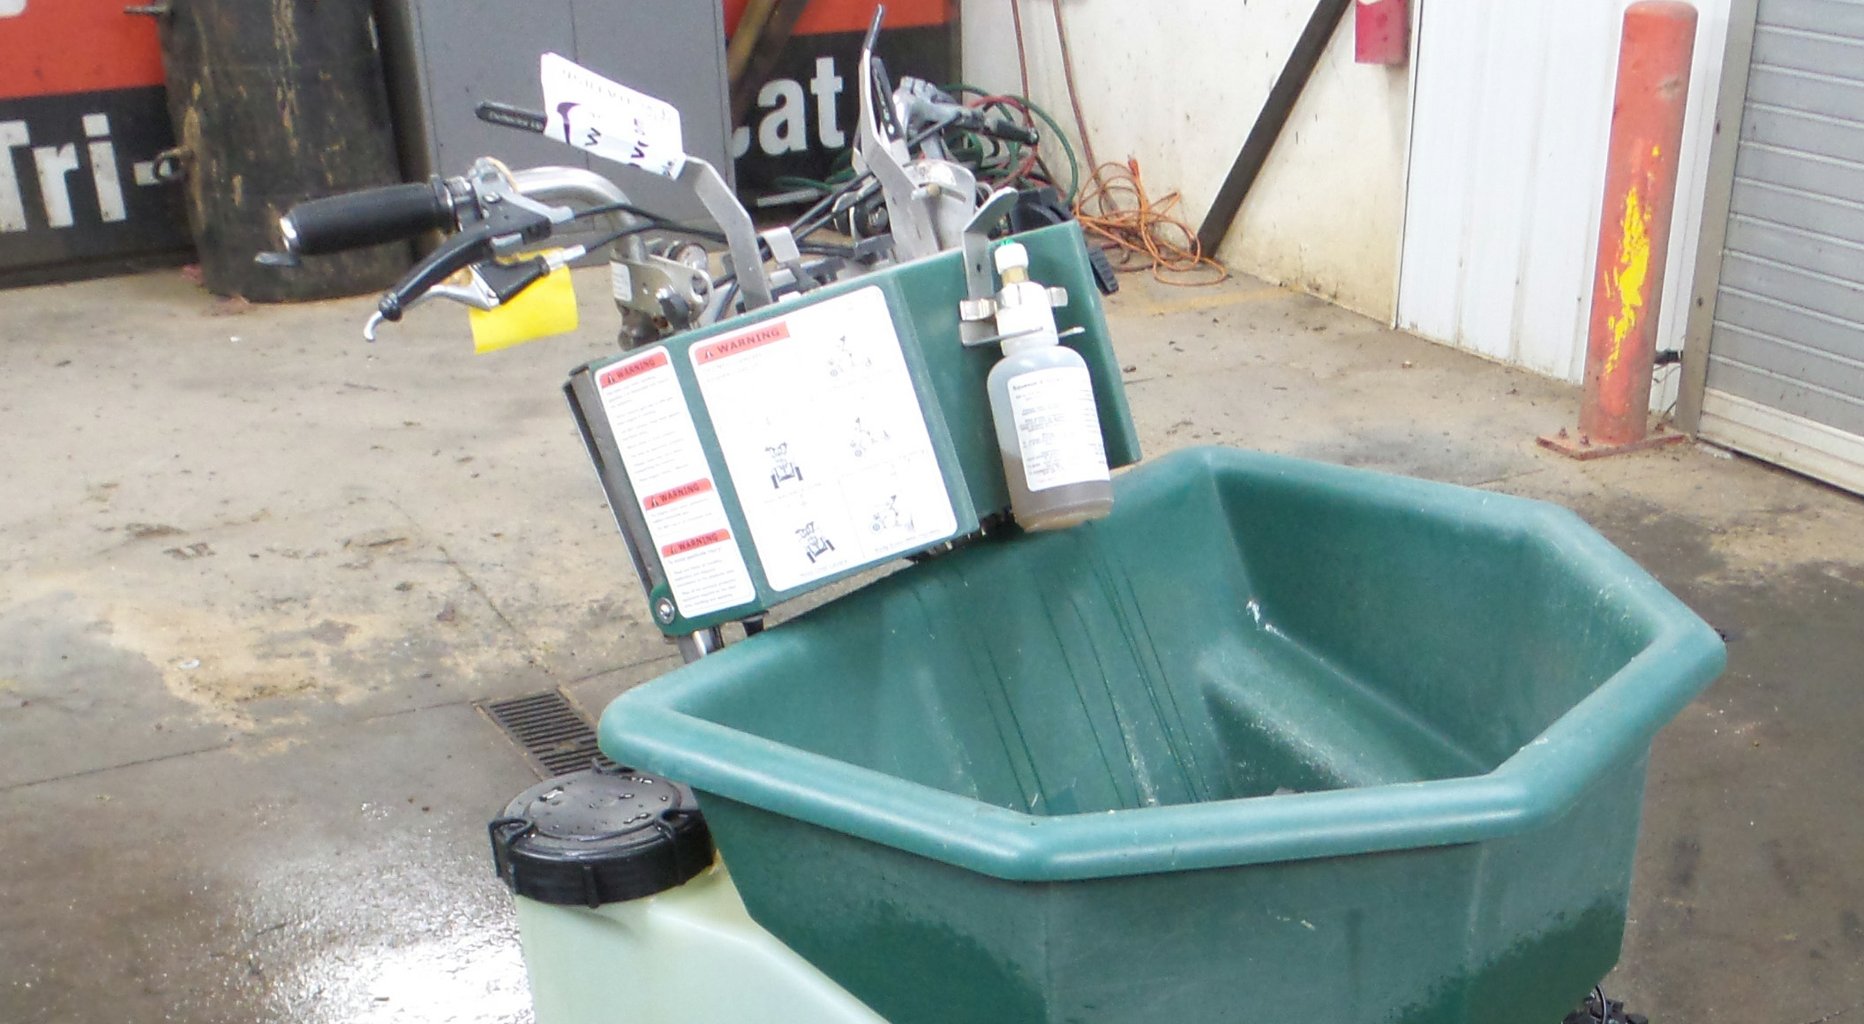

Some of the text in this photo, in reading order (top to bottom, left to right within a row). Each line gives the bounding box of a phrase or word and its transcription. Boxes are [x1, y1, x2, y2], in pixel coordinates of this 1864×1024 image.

[733, 56, 845, 159] at
[717, 328, 781, 355] WARNING
[616, 356, 657, 380] WARNING
[659, 482, 701, 503] WARNING
[678, 532, 720, 551] WARNING
